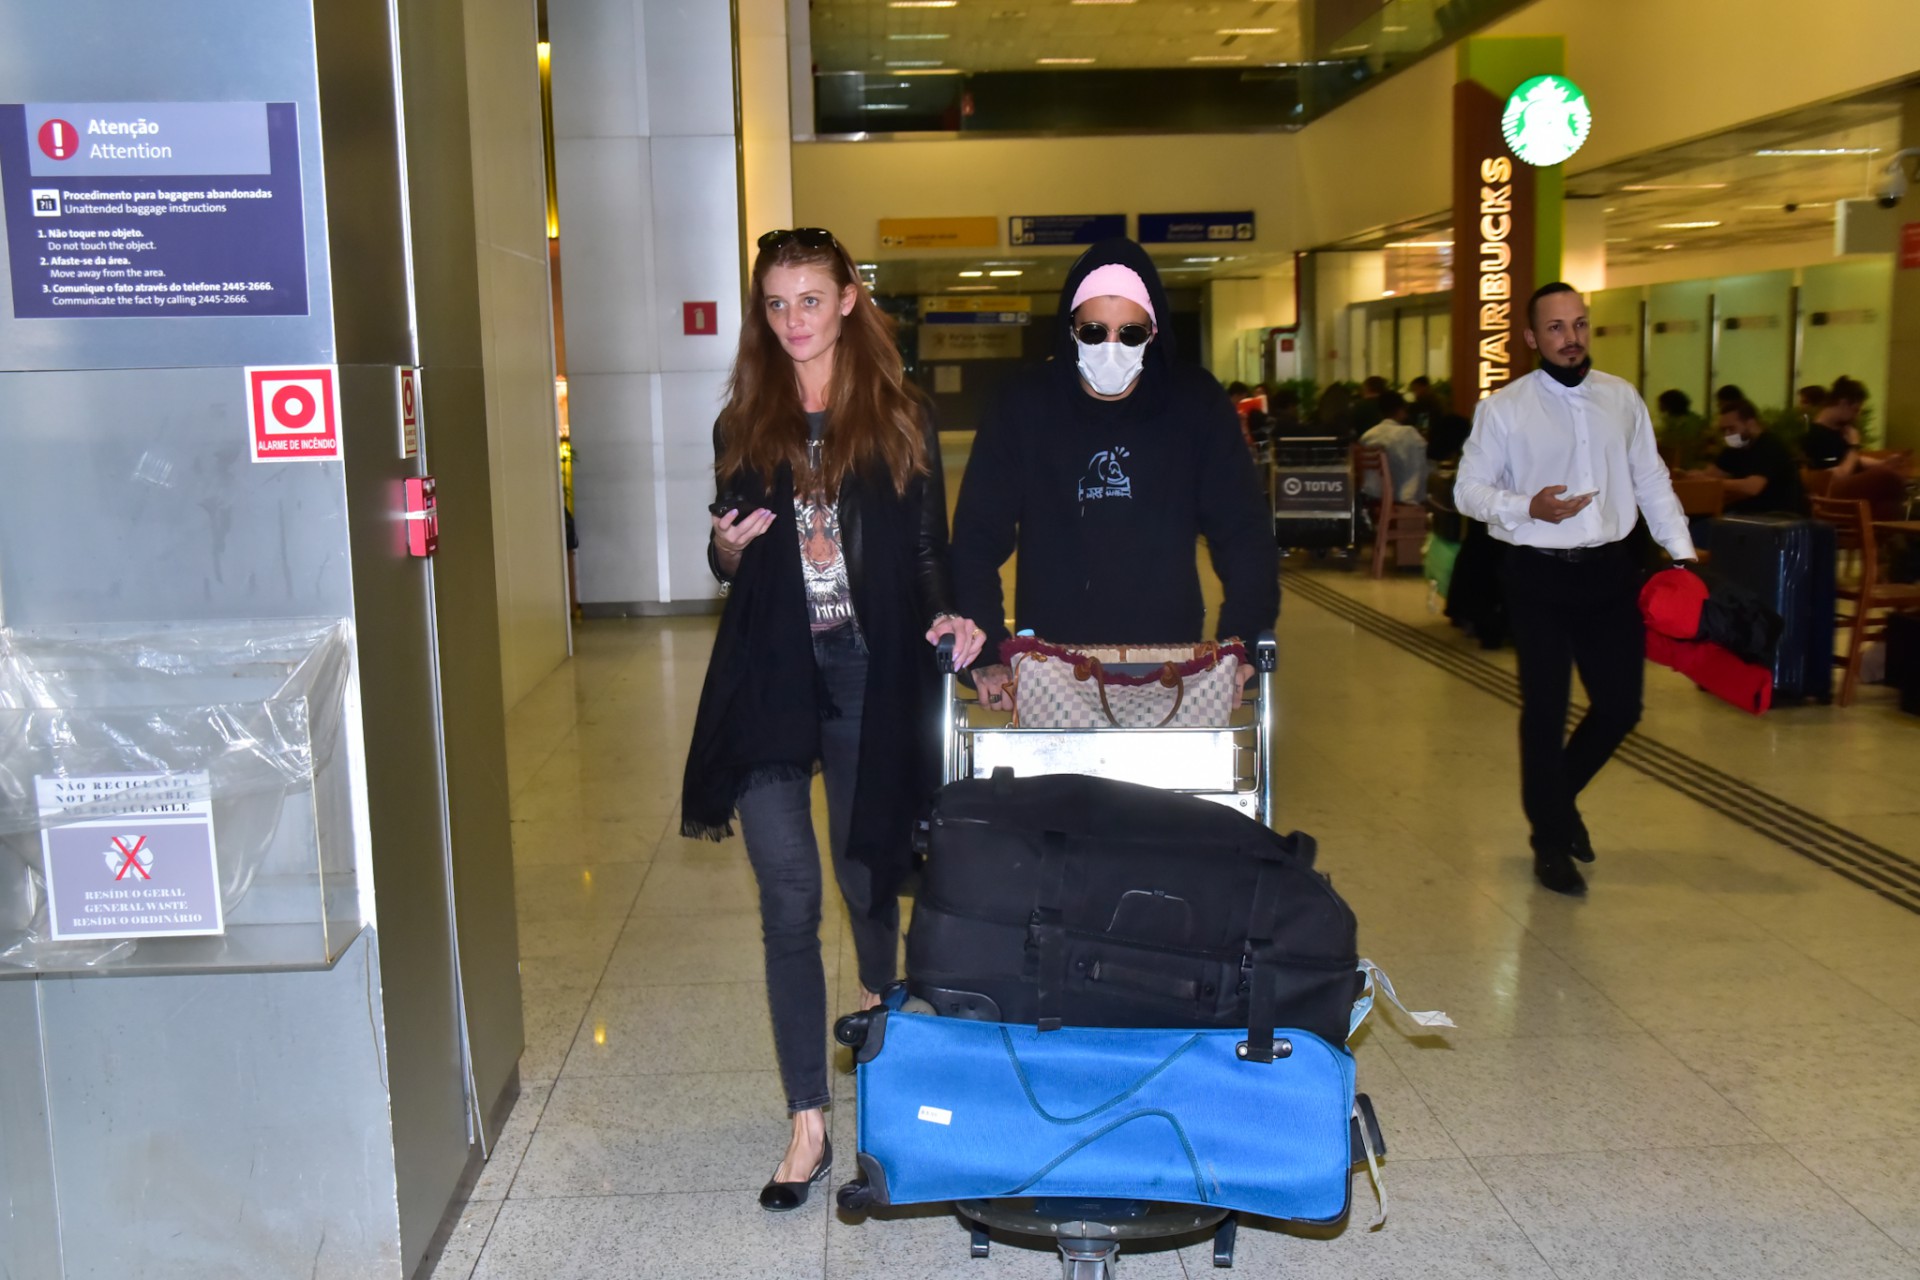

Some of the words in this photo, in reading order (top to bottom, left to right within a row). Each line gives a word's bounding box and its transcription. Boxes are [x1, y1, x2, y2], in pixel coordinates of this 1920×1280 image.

[88, 118, 159, 139] Atenção
[90, 142, 172, 159] Attention
[63, 189, 132, 201] Procedimento
[134, 191, 156, 202] para
[157, 189, 205, 202] bagagens
[206, 188, 272, 199] abandonadas
[65, 204, 124, 214] Unattended
[125, 204, 167, 216] baggage
[169, 202, 227, 213] instructions
[38, 229, 47, 238] 1.
[48, 229, 68, 238] Não
[69, 229, 97, 240] toque
[111, 228, 144, 239] objeto.
[48, 242, 62, 251] Do
[63, 242, 79, 250] not
[80, 241, 107, 250] touch
[108, 241, 125, 250] the
[125, 241, 157, 252] object.
[40, 257, 49, 266] 2.
[50, 257, 93, 266] Afaste-se
[94, 256, 107, 265] da
[108, 256, 131, 265] área.
[50, 269, 75, 278] Move
[77, 270, 100, 280] away
[102, 268, 125, 277] from
[126, 268, 142, 277] the
[143, 269, 166, 277] area.
[42, 284, 52, 293] 3.
[52, 284, 106, 294] Comunique
[106, 285, 114, 293] o
[114, 283, 134, 293] fato
[135, 283, 168, 292] através
[169, 282, 182, 292] do
[183, 282, 221, 291] telefone
[222, 281, 274, 291] 2445-2666.
[52, 296, 116, 306] Communicate
[117, 296, 133, 305] the
[134, 295, 152, 304] fact
[154, 295, 165, 307] by
[166, 295, 197, 306] calling
[198, 294, 249, 304] 2445-2666.
[258, 440, 289, 451] ALARME
[289, 440, 300, 450] DE
[301, 436, 336, 449] INCÊNDIO
[1304, 481, 1343, 492] TOTVS
[56, 794, 86, 803] NOT
[85, 889, 142, 900] RESÍDUO
[143, 888, 186, 898] GERAL
[84, 903, 145, 913] GENERAL
[145, 901, 189, 911] WASTE
[73, 916, 129, 927] RESÍDUO
[131, 913, 203, 925] ORDINÁRIO
